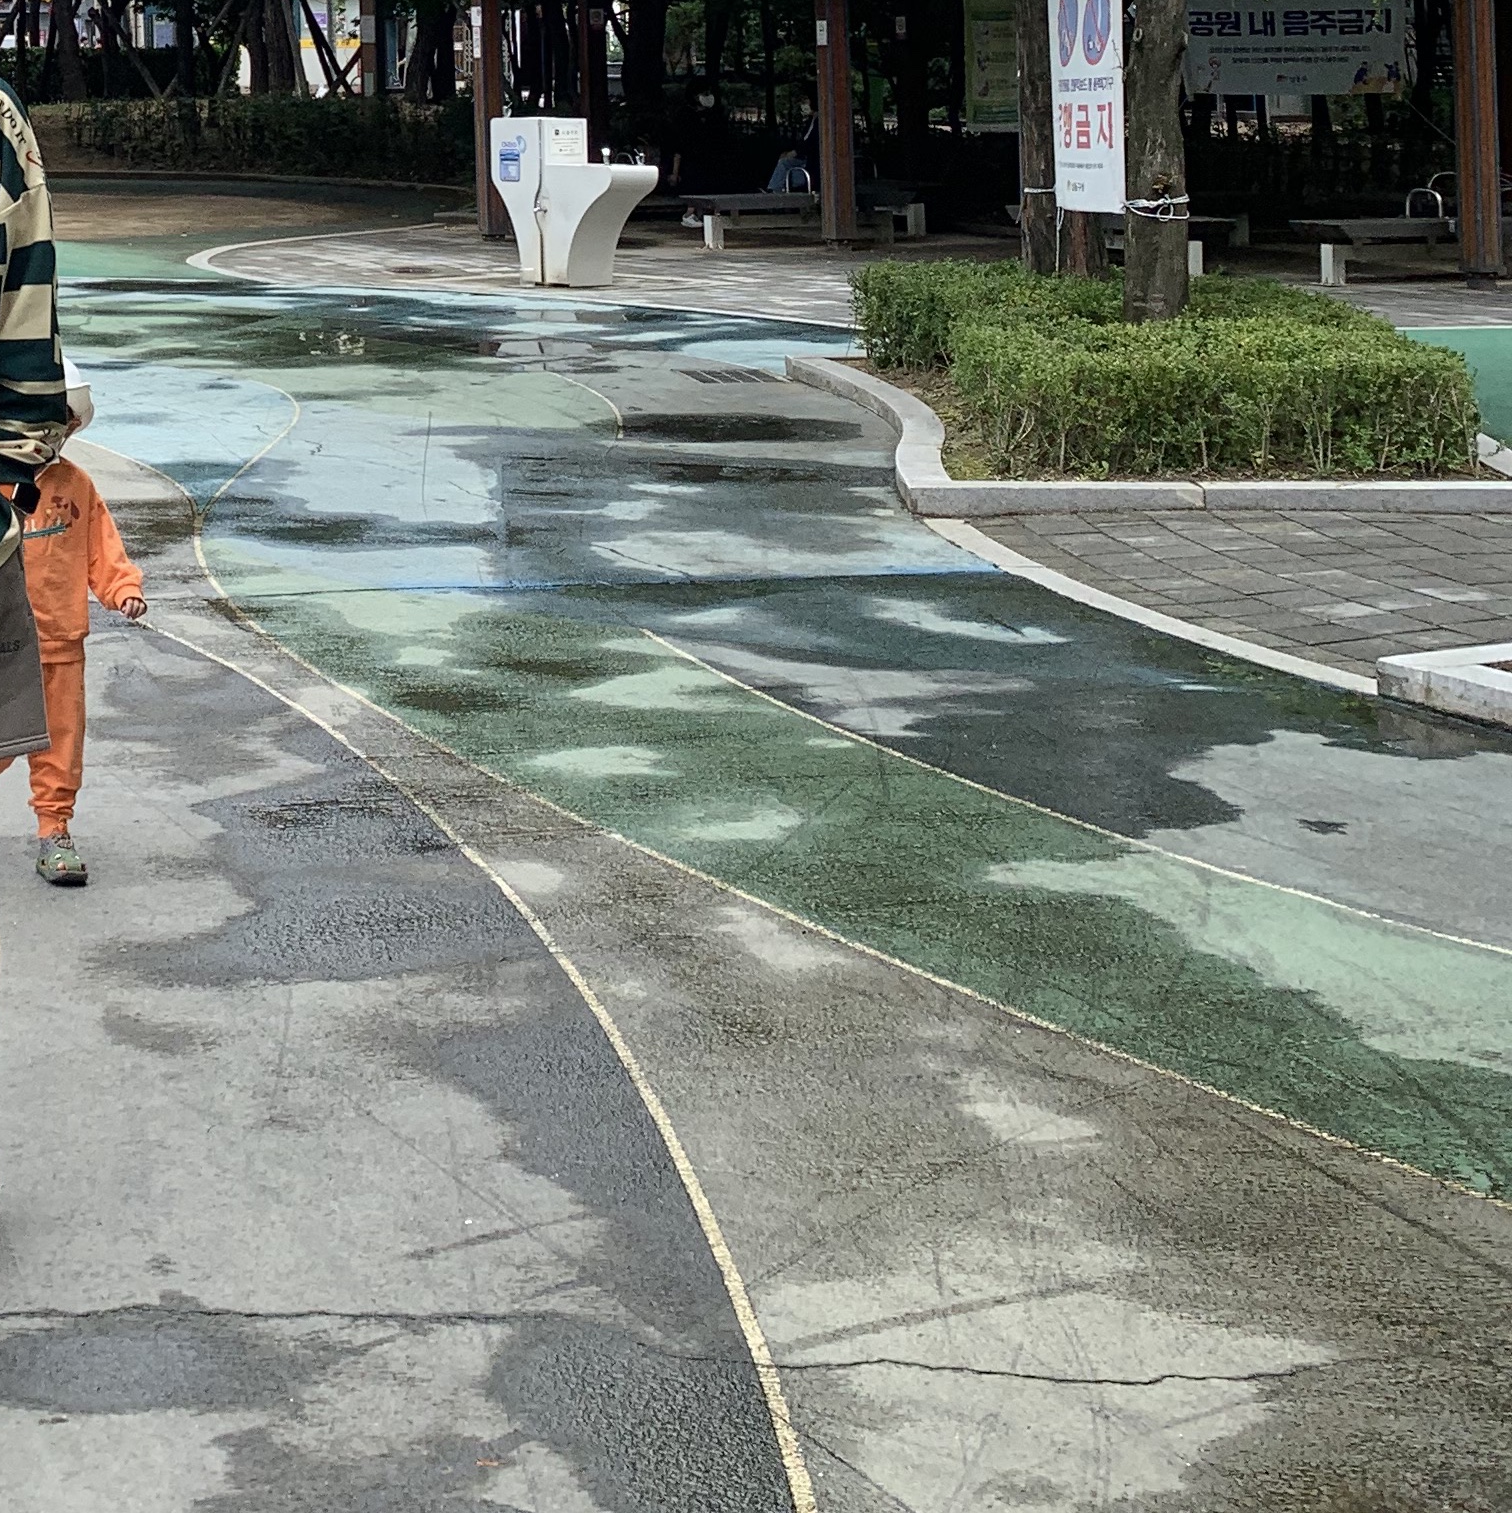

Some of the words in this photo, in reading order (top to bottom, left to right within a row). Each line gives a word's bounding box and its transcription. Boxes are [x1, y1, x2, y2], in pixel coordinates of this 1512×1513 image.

[1189, 10, 1242, 37] 공원
[1248, 10, 1277, 37] 내
[1282, 8, 1392, 37] 음주금지
